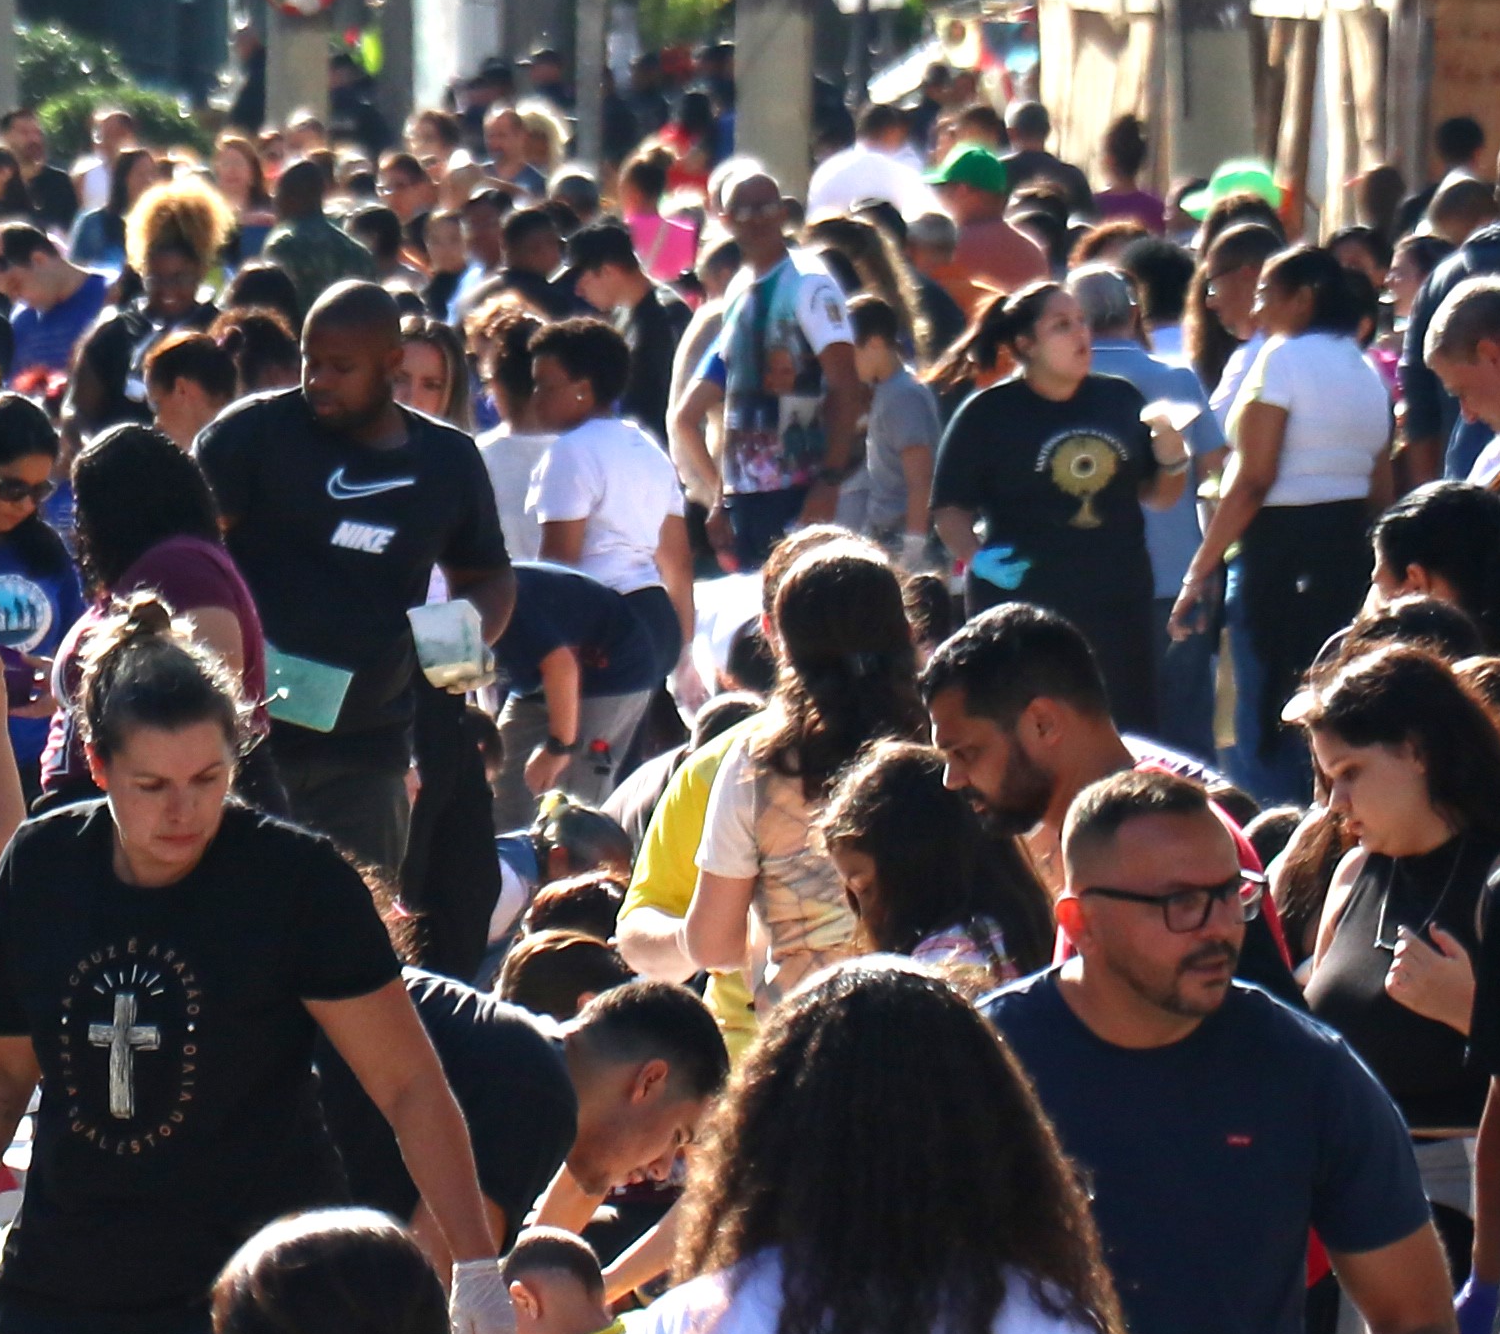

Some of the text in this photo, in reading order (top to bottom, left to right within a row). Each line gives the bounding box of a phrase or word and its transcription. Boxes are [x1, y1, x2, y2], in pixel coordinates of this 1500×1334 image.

[331, 520, 397, 555] NIKE
[69, 945, 116, 986] CRUZ
[116, 1110, 184, 1155] ESTOU
